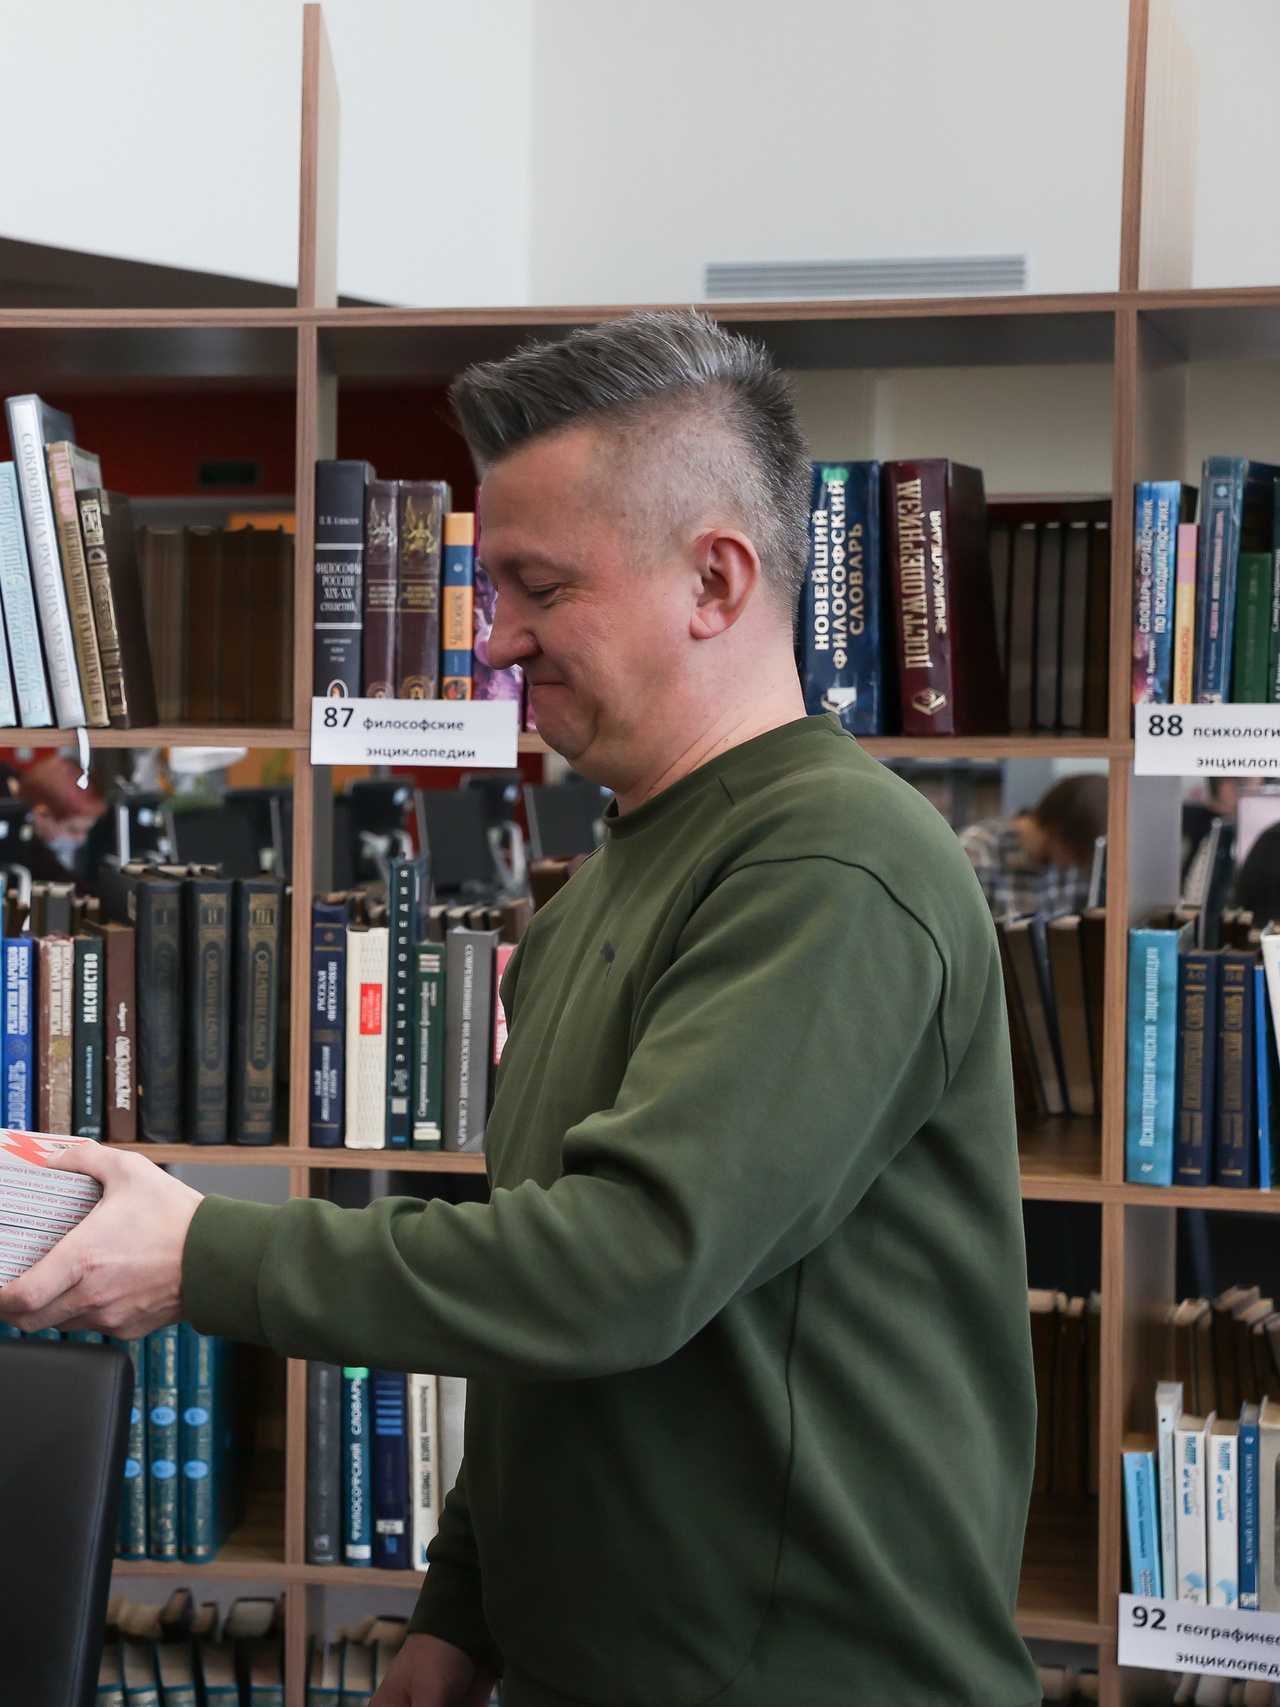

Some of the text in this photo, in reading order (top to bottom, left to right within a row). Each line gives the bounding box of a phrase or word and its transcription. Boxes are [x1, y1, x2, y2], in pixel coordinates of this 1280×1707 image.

[21, 433, 70, 689] СОКРОВИЩА РУССКИХ МУЗЕЕВ
[322, 575, 356, 587] РОССИИ
[811, 510, 830, 651] НОВЕЙШИЙ
[827, 480, 848, 669] ФИЛОСОФСКИЙ
[849, 523, 865, 636] СЛОВАРЬ
[896, 477, 934, 669] ПОСТМОДЕРНИЗМ
[929, 510, 948, 634] ЭНЦИКЛОПЕДИЯ
[1154, 500, 1170, 634] ПО ПСИХОДИАГНОСТИКЕ
[324, 707, 464, 732] 87 философские
[366, 748, 476, 760] энциклопедии
[1149, 715, 1183, 736] 88
[1197, 758, 1280, 769] энциклоп
[7, 946, 19, 1035] РЕЛИГИИ НАРОДОВ
[18, 946, 28, 978] РОССИИ
[83, 953, 98, 1023] МАСОНСТВО
[50, 991, 62, 1036] РЕЛИГИИ
[204, 949, 220, 1060] ХРИСТИАНСТВО
[253, 949, 270, 1061] ХРИСТИАНСТВО
[115, 1036, 131, 1110] ХРИСТИАНСТВО
[1138, 947, 1160, 1147] Психотерапевтическая энциклопедия
[8, 1060, 27, 1130] СЛОВАРЬ
[1, 1202, 26, 1212] КРАСНОМ
[4, 1178, 28, 1188] КРАСНОМ
[5, 1190, 30, 1200] КРАСНОМ
[350, 1378, 363, 1435] СЛОВАРЬ
[1132, 1605, 1167, 1631] 92
